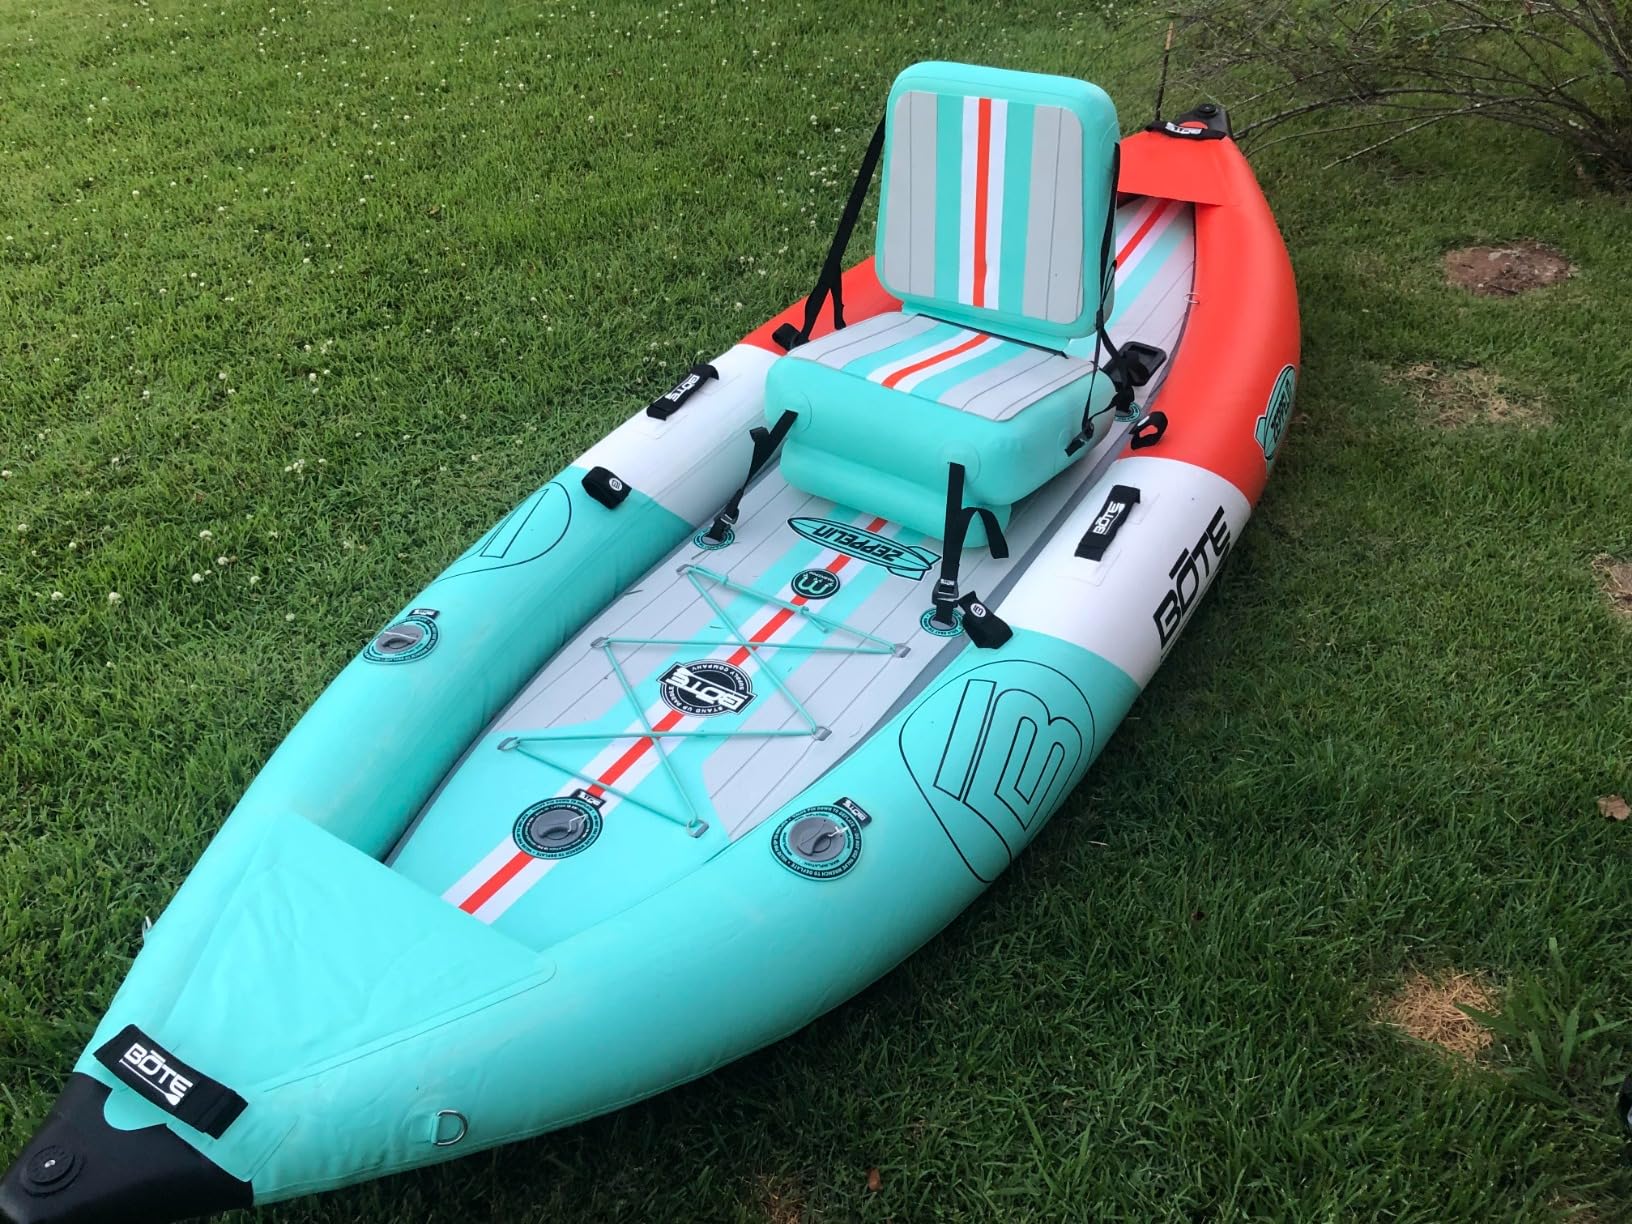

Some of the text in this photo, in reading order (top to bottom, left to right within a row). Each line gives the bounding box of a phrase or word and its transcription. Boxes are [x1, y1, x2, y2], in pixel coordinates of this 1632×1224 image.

[812, 525, 904, 562] ZEPPELIN
[692, 664, 745, 691] SUPPLY COMPANY
